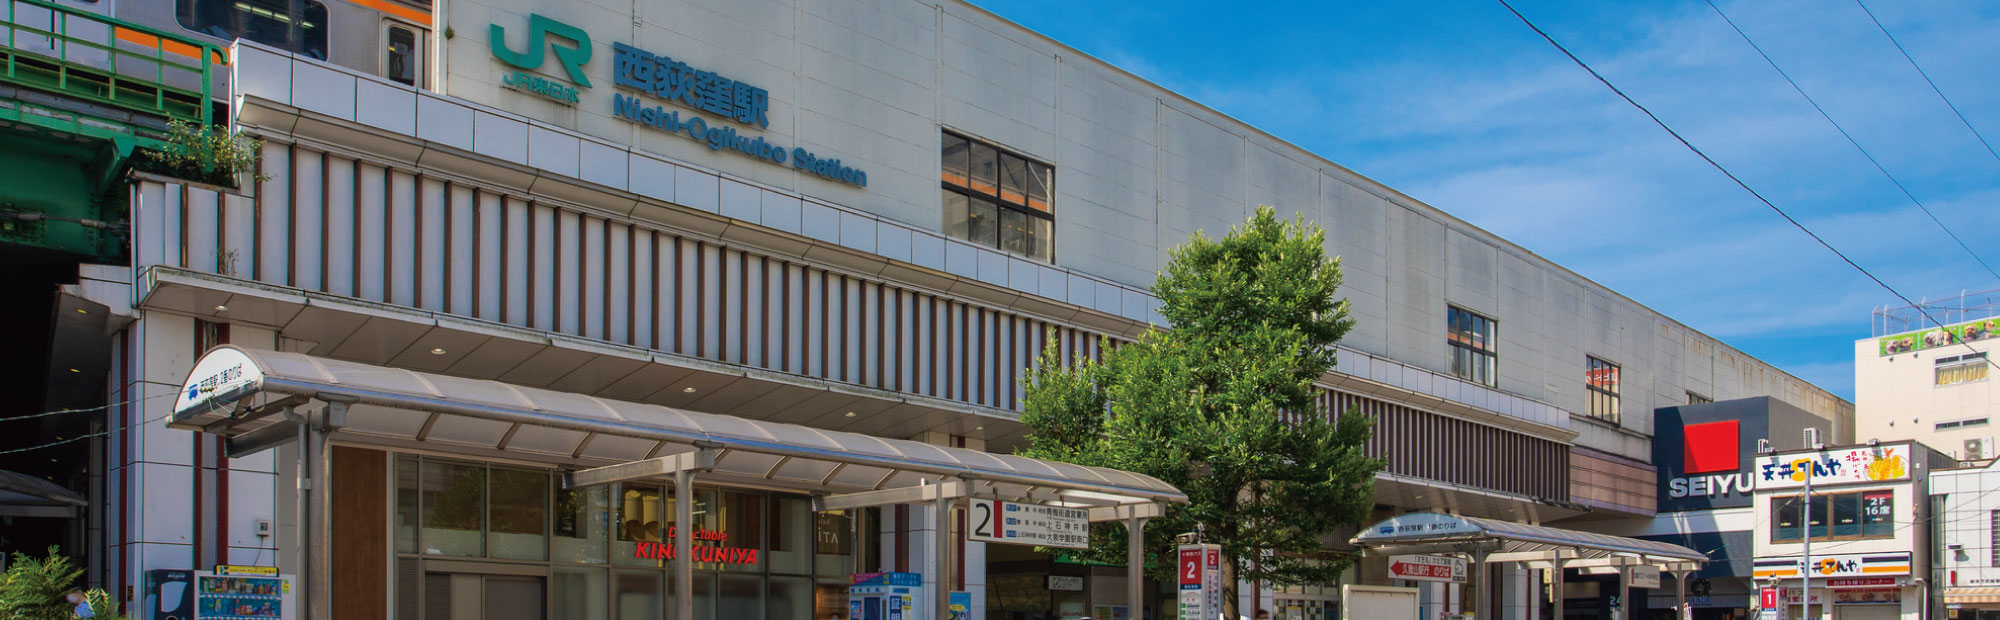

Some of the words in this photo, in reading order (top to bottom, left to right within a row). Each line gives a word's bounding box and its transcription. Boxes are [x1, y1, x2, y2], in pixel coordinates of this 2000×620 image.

[490, 13, 592, 88] JR
[503, 71, 580, 103] JR東日本
[612, 41, 769, 129] 西荻窪駅
[613, 93, 787, 164] Nishi-Ogikubo
[793, 147, 867, 188] Station
[1669, 472, 1754, 497] SEIYU
[1870, 497, 1885, 505] 2F
[1865, 506, 1890, 515] 16席
[975, 503, 991, 537] 2
[1047, 520, 1088, 533] 上石神井駅
[699, 528, 727, 542] Table
[635, 541, 758, 565] KINKUNIYA
[1209, 555, 1215, 564] 2
[1187, 561, 1196, 579] 2
[1434, 566, 1450, 577] のりば
[1767, 593, 1773, 605] 1
